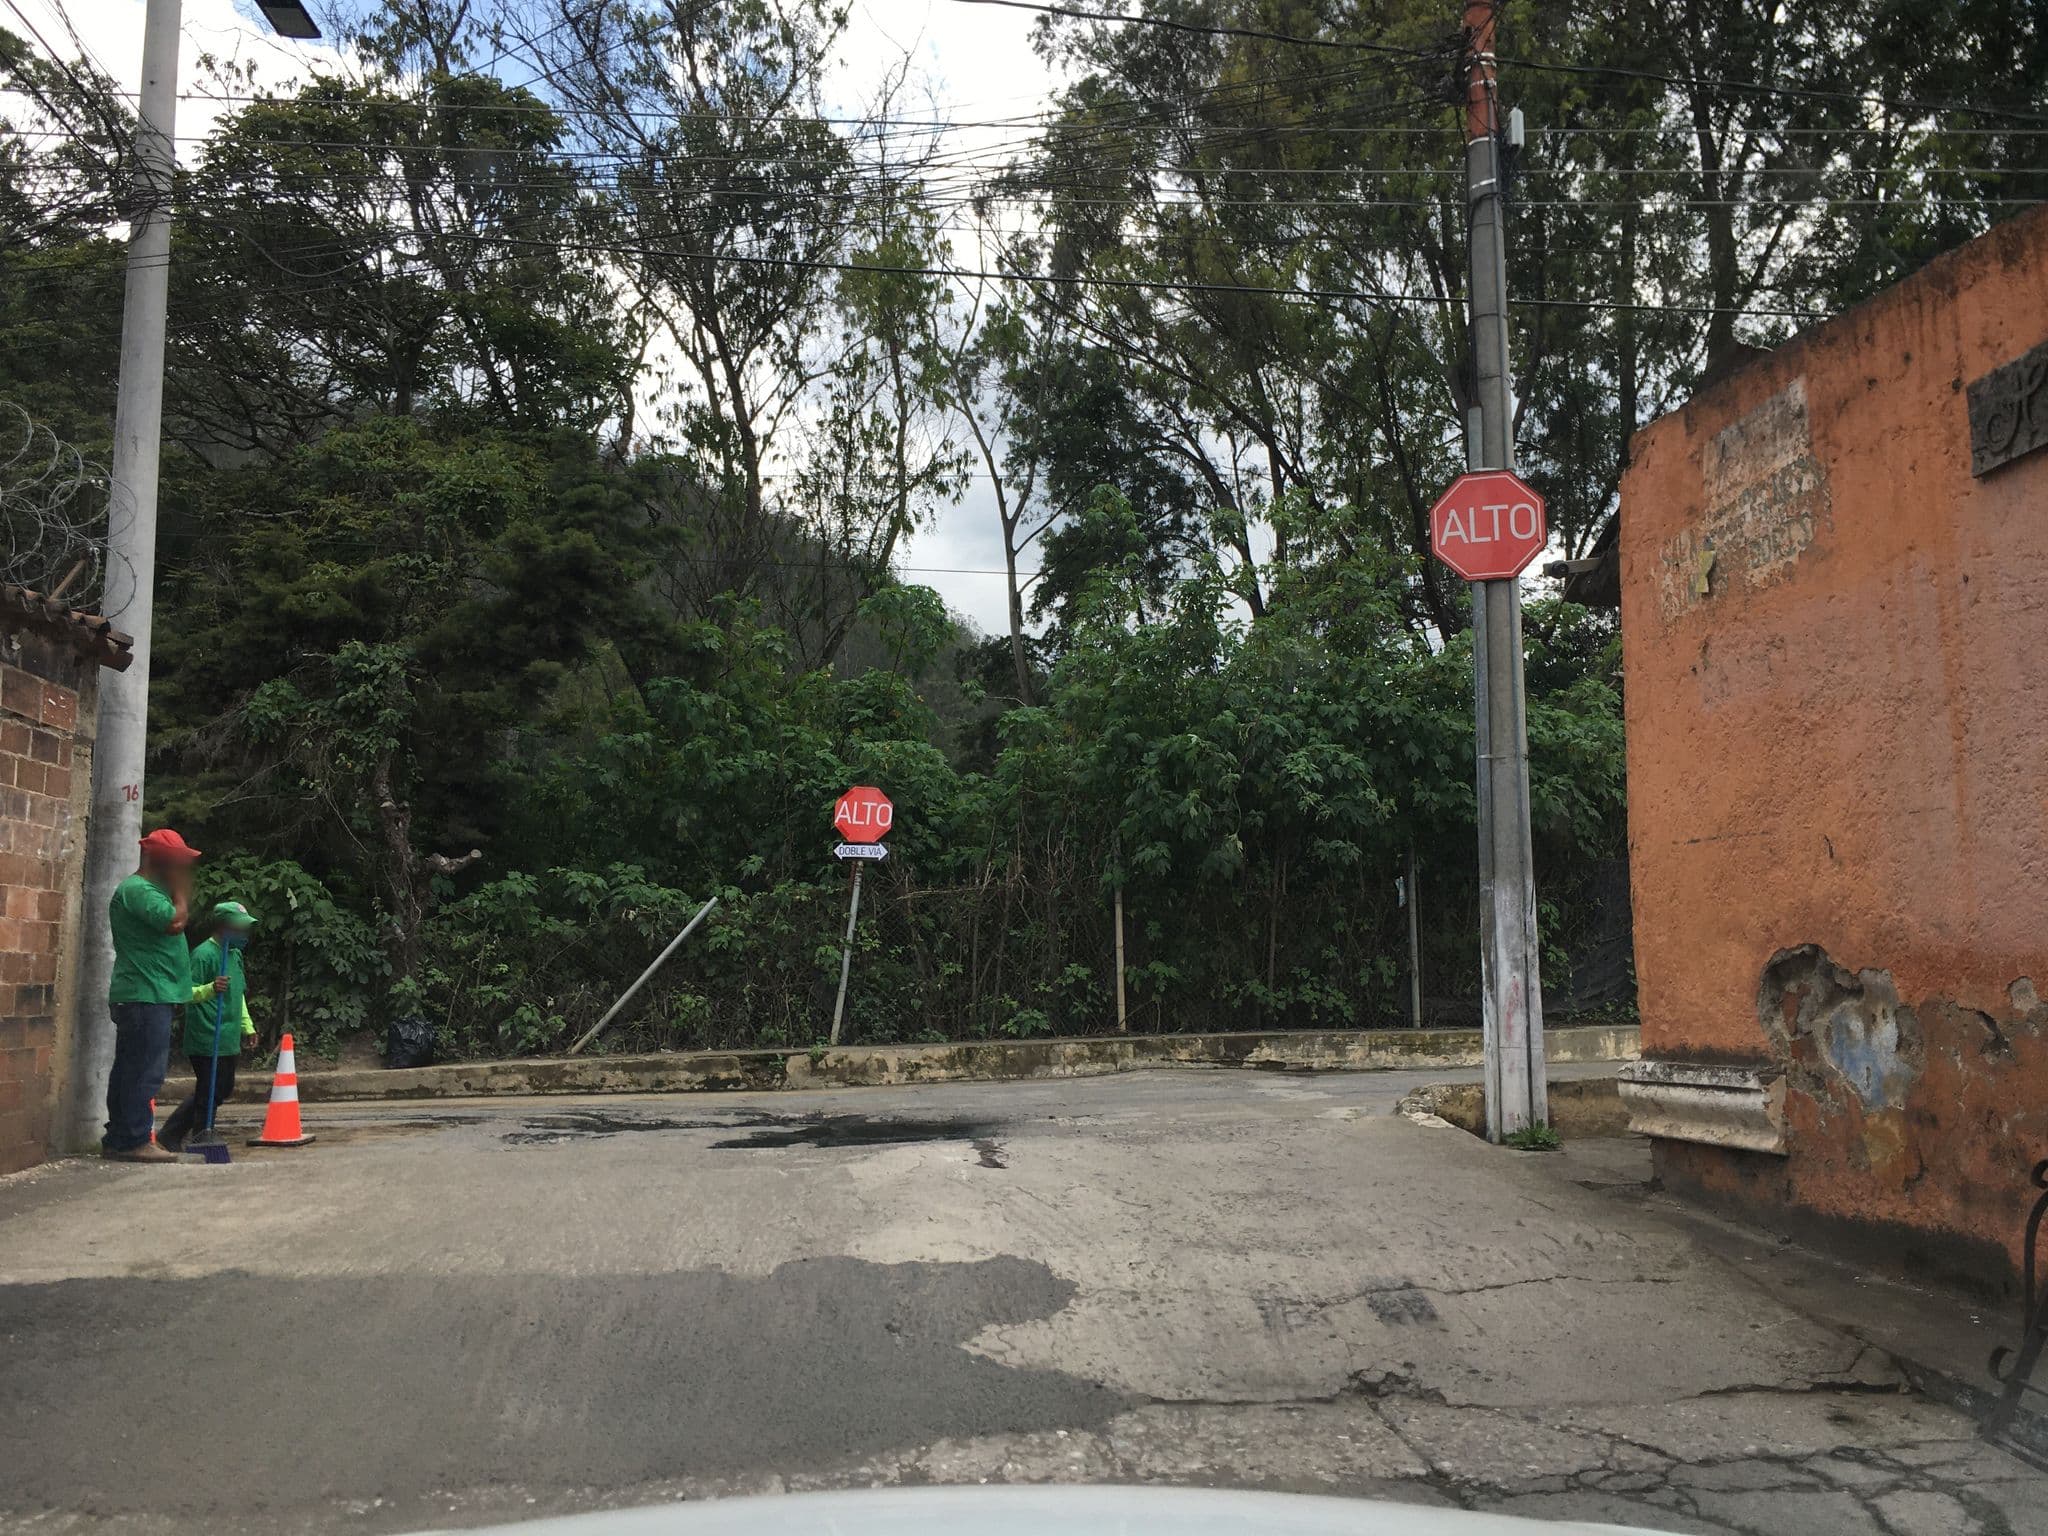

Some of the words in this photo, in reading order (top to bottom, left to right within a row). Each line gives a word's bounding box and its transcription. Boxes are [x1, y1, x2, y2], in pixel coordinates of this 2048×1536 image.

[1440, 503, 1537, 546] ALTO
[834, 800, 893, 827] ALTO
[838, 846, 866, 856] DOBLE
[868, 847, 882, 856] VIA
